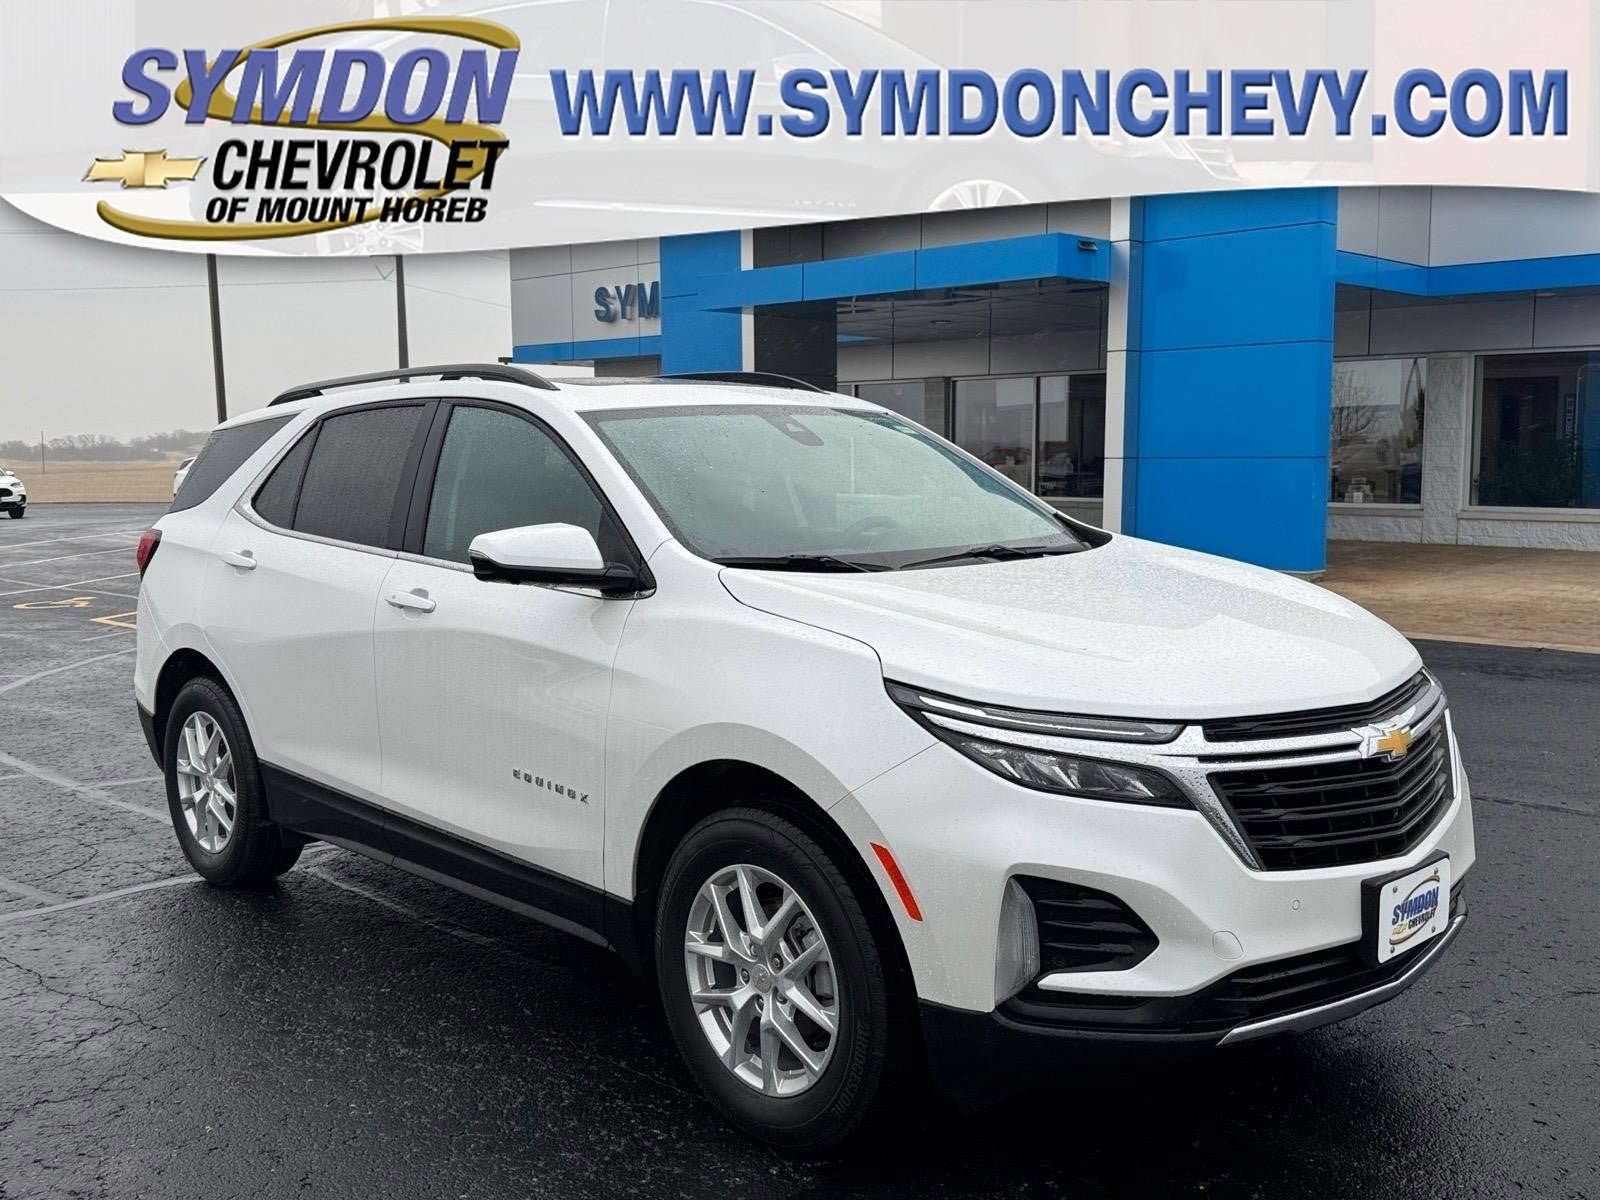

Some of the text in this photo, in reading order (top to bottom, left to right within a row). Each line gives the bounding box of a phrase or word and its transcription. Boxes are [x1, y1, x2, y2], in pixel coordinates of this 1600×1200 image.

[594, 281, 661, 323] SYM
[512, 768, 589, 805] EQUINOX
[1391, 886, 1440, 926] SYMDON
[1407, 907, 1437, 930] CHEVROLET
